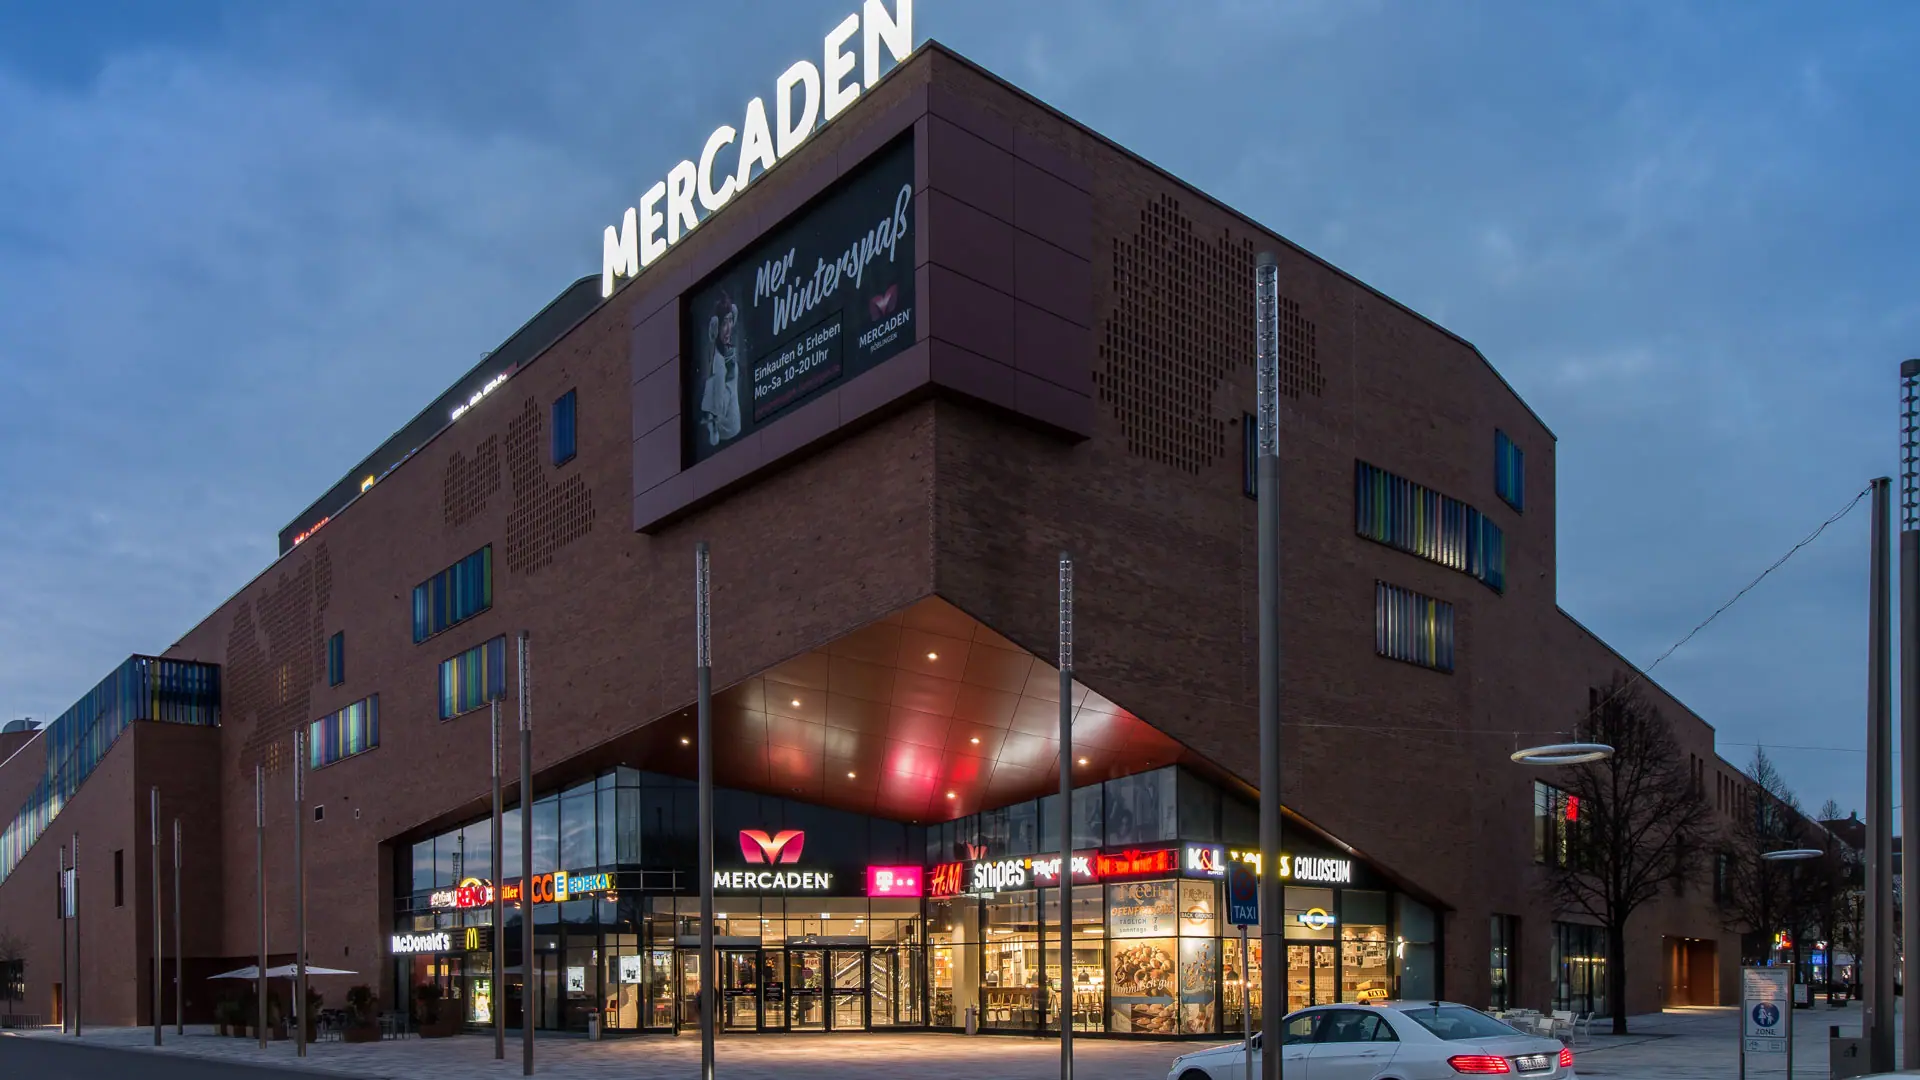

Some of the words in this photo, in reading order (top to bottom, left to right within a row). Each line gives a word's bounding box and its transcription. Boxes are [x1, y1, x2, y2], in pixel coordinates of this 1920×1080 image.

[602, 0, 912, 299] MERCADEN
[773, 184, 912, 335] Winterspaß
[754, 248, 795, 307] Mer
[859, 309, 910, 348] MERCADEN
[754, 350, 795, 382] Einkaufen
[797, 342, 804, 357] &
[806, 323, 840, 351] Erleben
[754, 376, 781, 400] Mo-Sa
[784, 357, 810, 383] 10-20
[812, 348, 829, 366] Uhr
[1188, 848, 1225, 872] K&L
[1294, 856, 1351, 883] COLLOSEUM
[520, 873, 553, 903] CC
[568, 873, 608, 894] EDEKA
[713, 871, 829, 889] MERCADEN
[932, 862, 962, 896] H&M
[1233, 905, 1256, 920] TAXI
[392, 932, 450, 953] McDonald's
